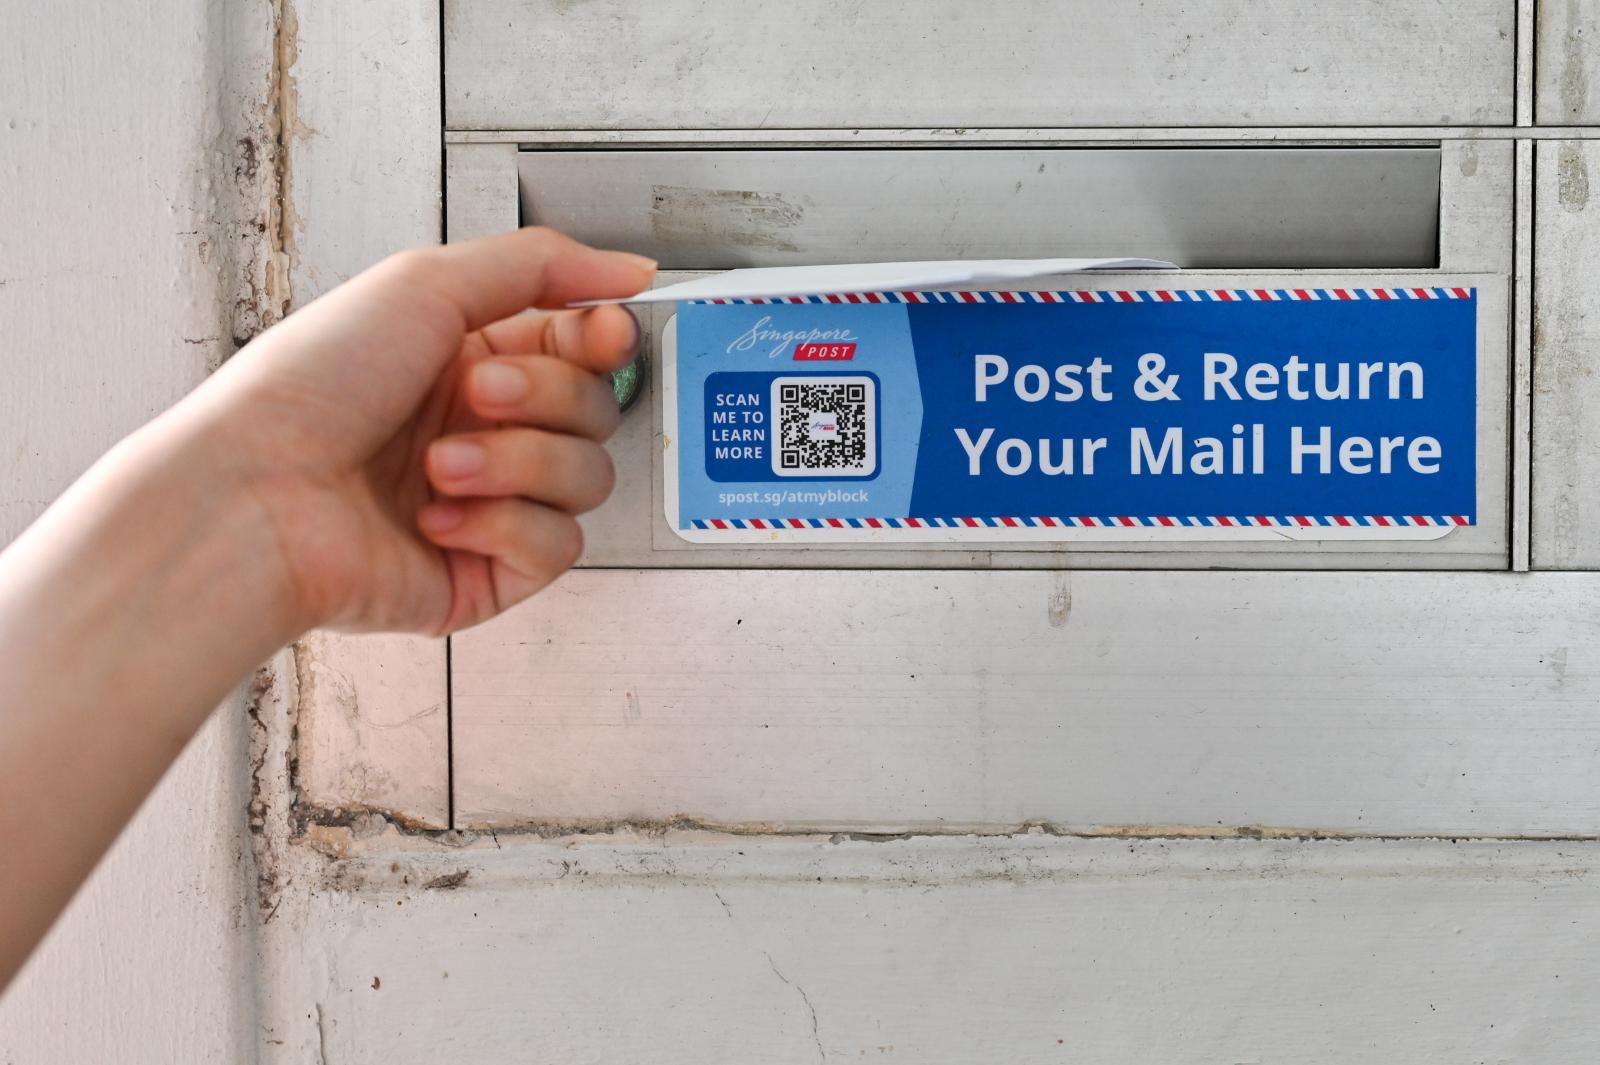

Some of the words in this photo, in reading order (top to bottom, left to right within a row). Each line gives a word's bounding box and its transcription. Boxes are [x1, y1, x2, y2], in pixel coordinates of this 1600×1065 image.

[727, 316, 858, 359] Singapore
[807, 346, 851, 358] POST
[973, 354, 1113, 402] Post
[1134, 352, 1181, 401] &
[1203, 352, 1425, 401] Return
[716, 393, 760, 406] SCAN
[713, 411, 736, 424] ME
[744, 411, 764, 423] TO
[712, 429, 765, 441] LEARN
[715, 446, 763, 459] MORE
[954, 428, 1107, 476] Your
[1130, 424, 1264, 475] Mail
[1290, 426, 1442, 475] Here
[719, 489, 869, 506] spost.sg/atmyblock
